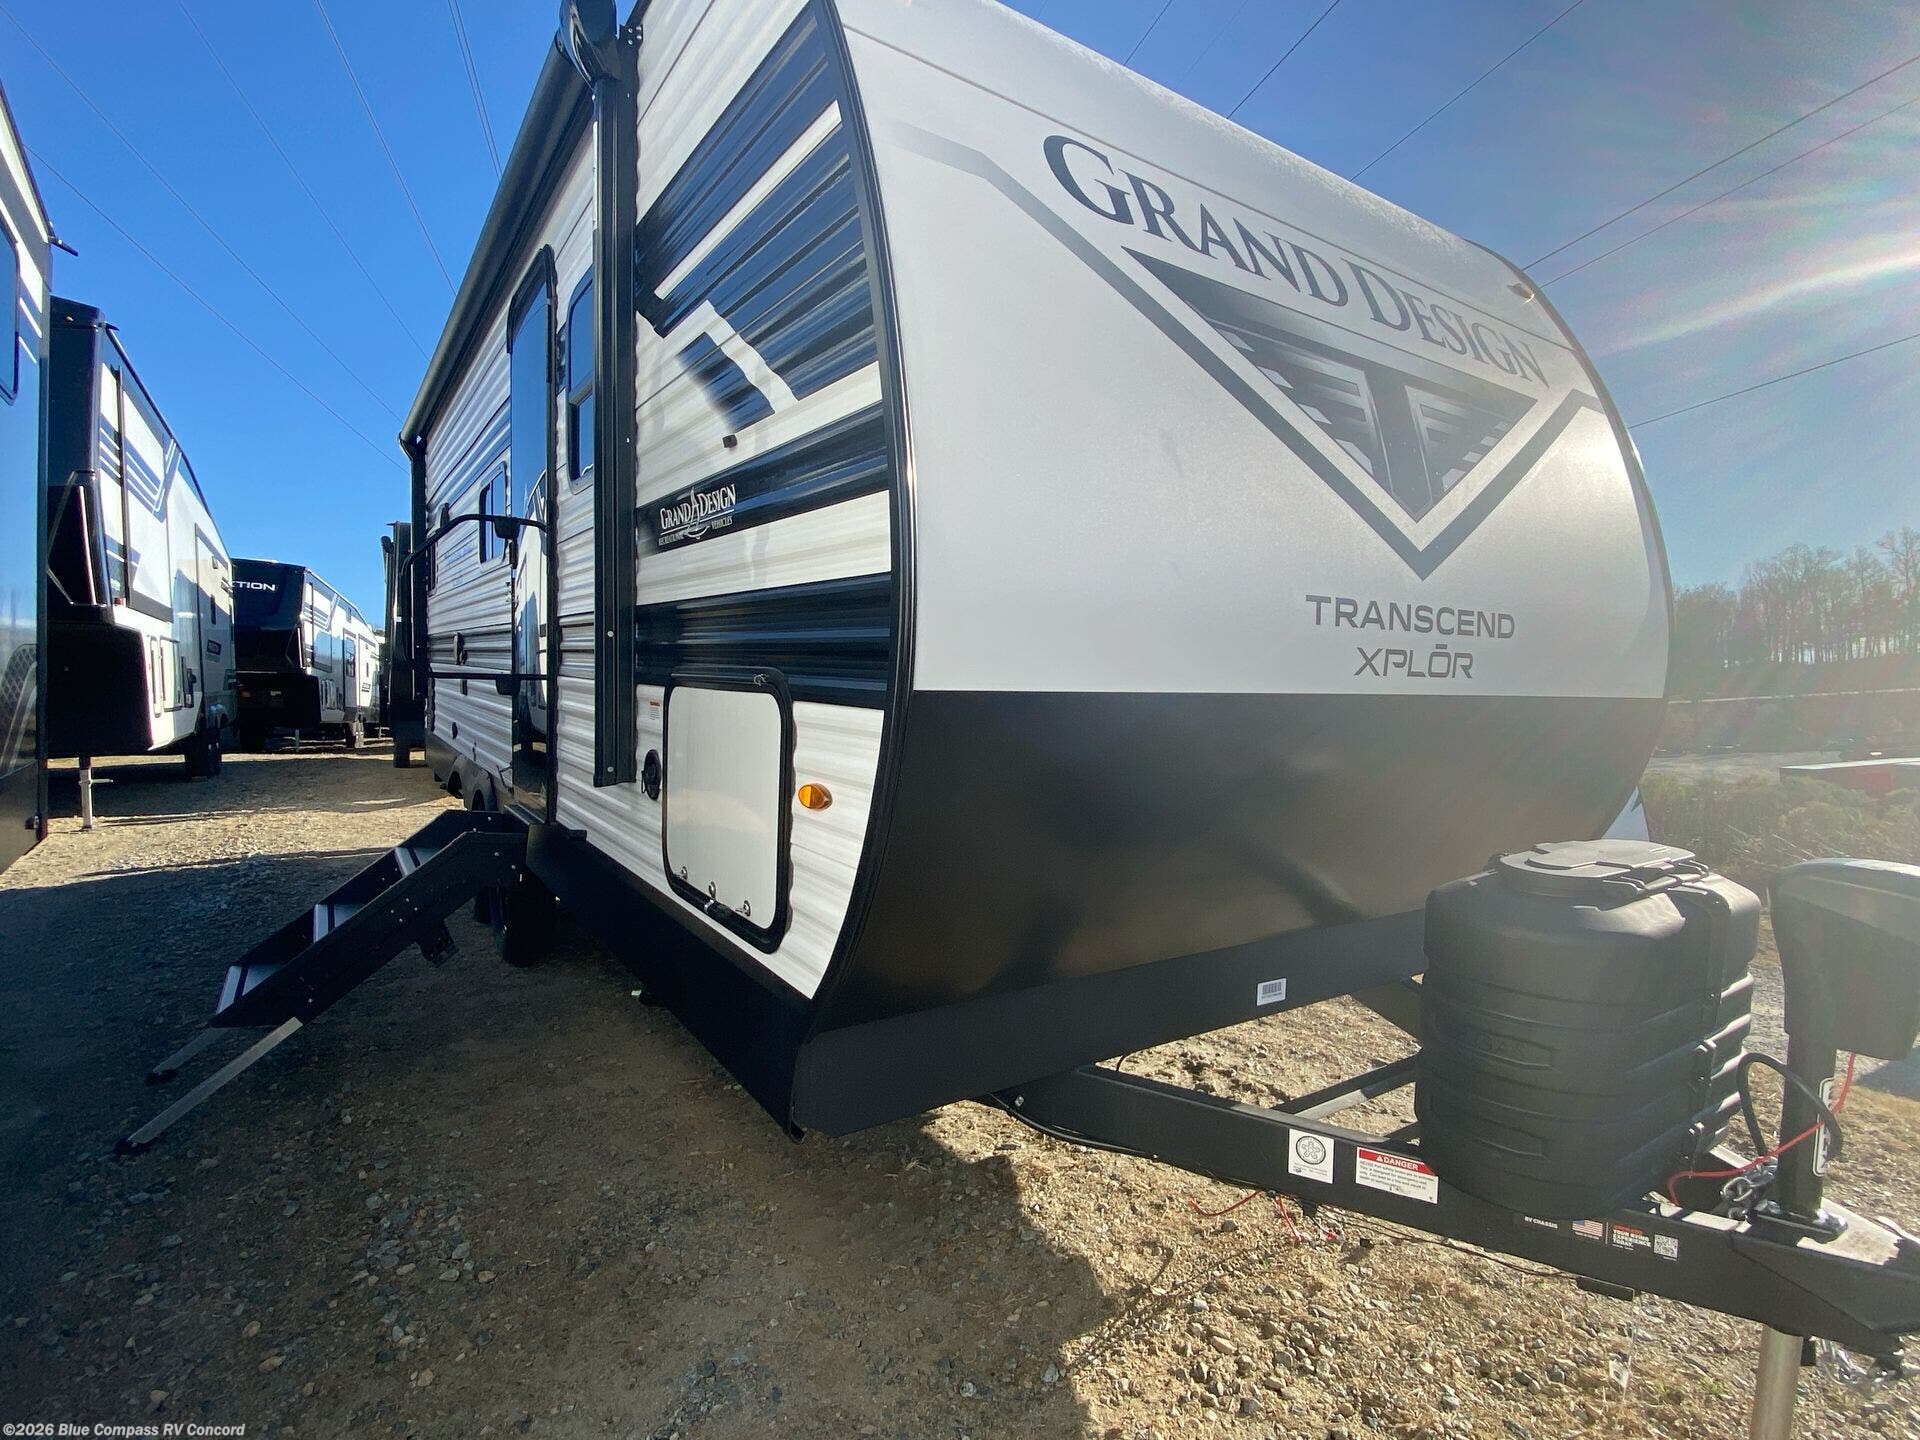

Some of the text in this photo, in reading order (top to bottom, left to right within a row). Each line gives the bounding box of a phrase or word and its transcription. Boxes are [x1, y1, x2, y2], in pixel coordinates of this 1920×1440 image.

[1043, 134, 1550, 390] GRAND DESIGN
[660, 484, 736, 529] GRAND DESIGN
[233, 580, 276, 591] TION
[1305, 594, 1515, 639] TRANSCEND
[1383, 1156, 1419, 1171] DANGER
